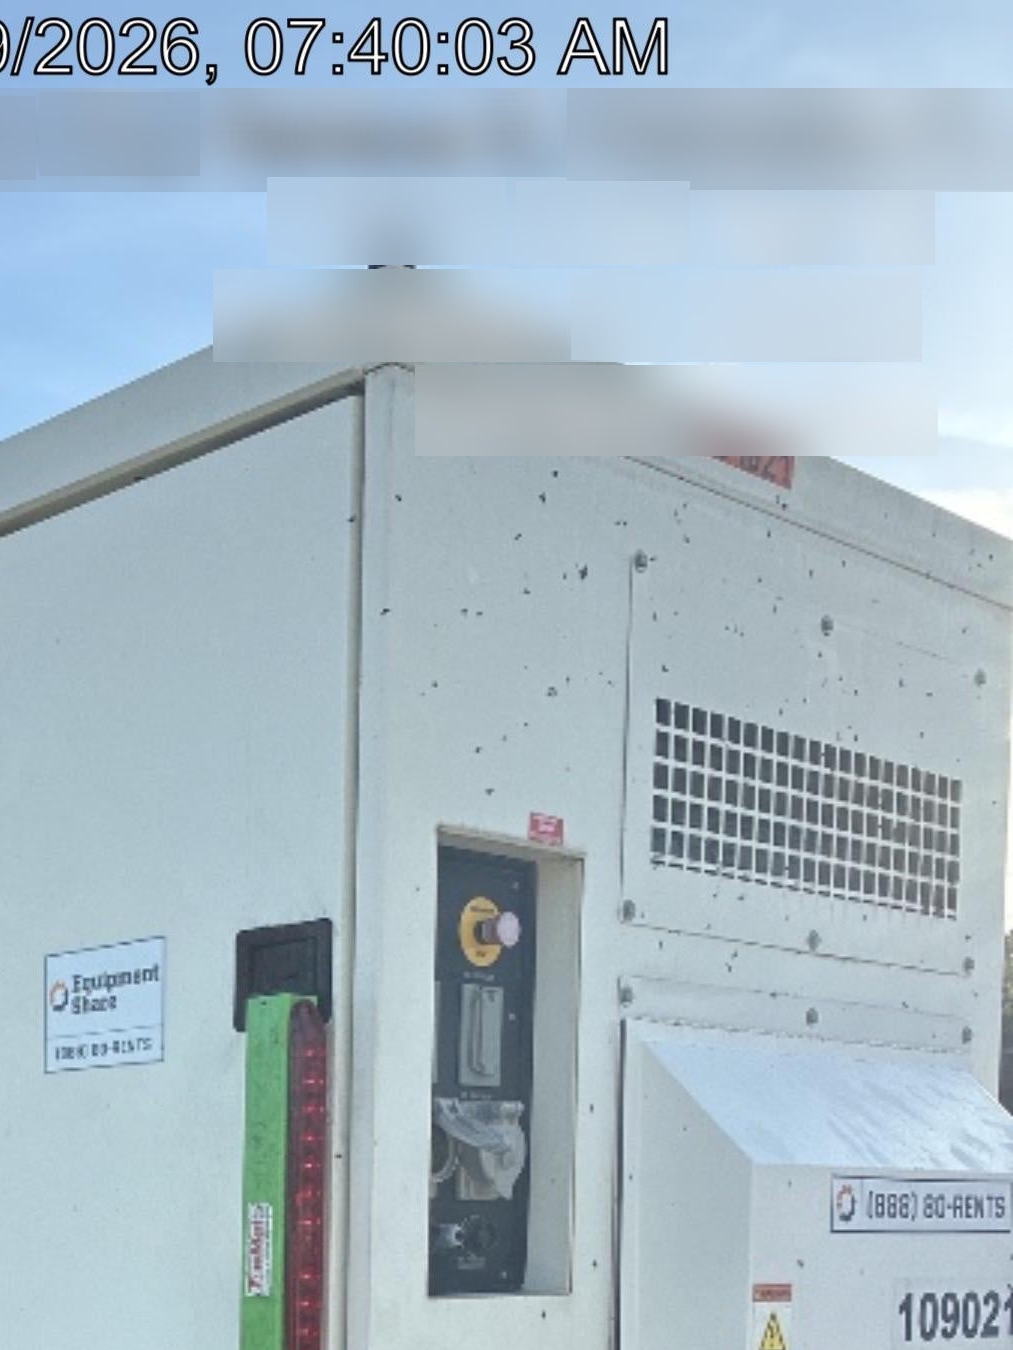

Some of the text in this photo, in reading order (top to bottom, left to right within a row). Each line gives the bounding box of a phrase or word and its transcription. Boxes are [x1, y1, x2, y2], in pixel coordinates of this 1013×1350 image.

[71, 964, 159, 1015] Equipment Share
[867, 1190, 1006, 1222] (888) 80-RENTS
[899, 1291, 1013, 1341] 109021
